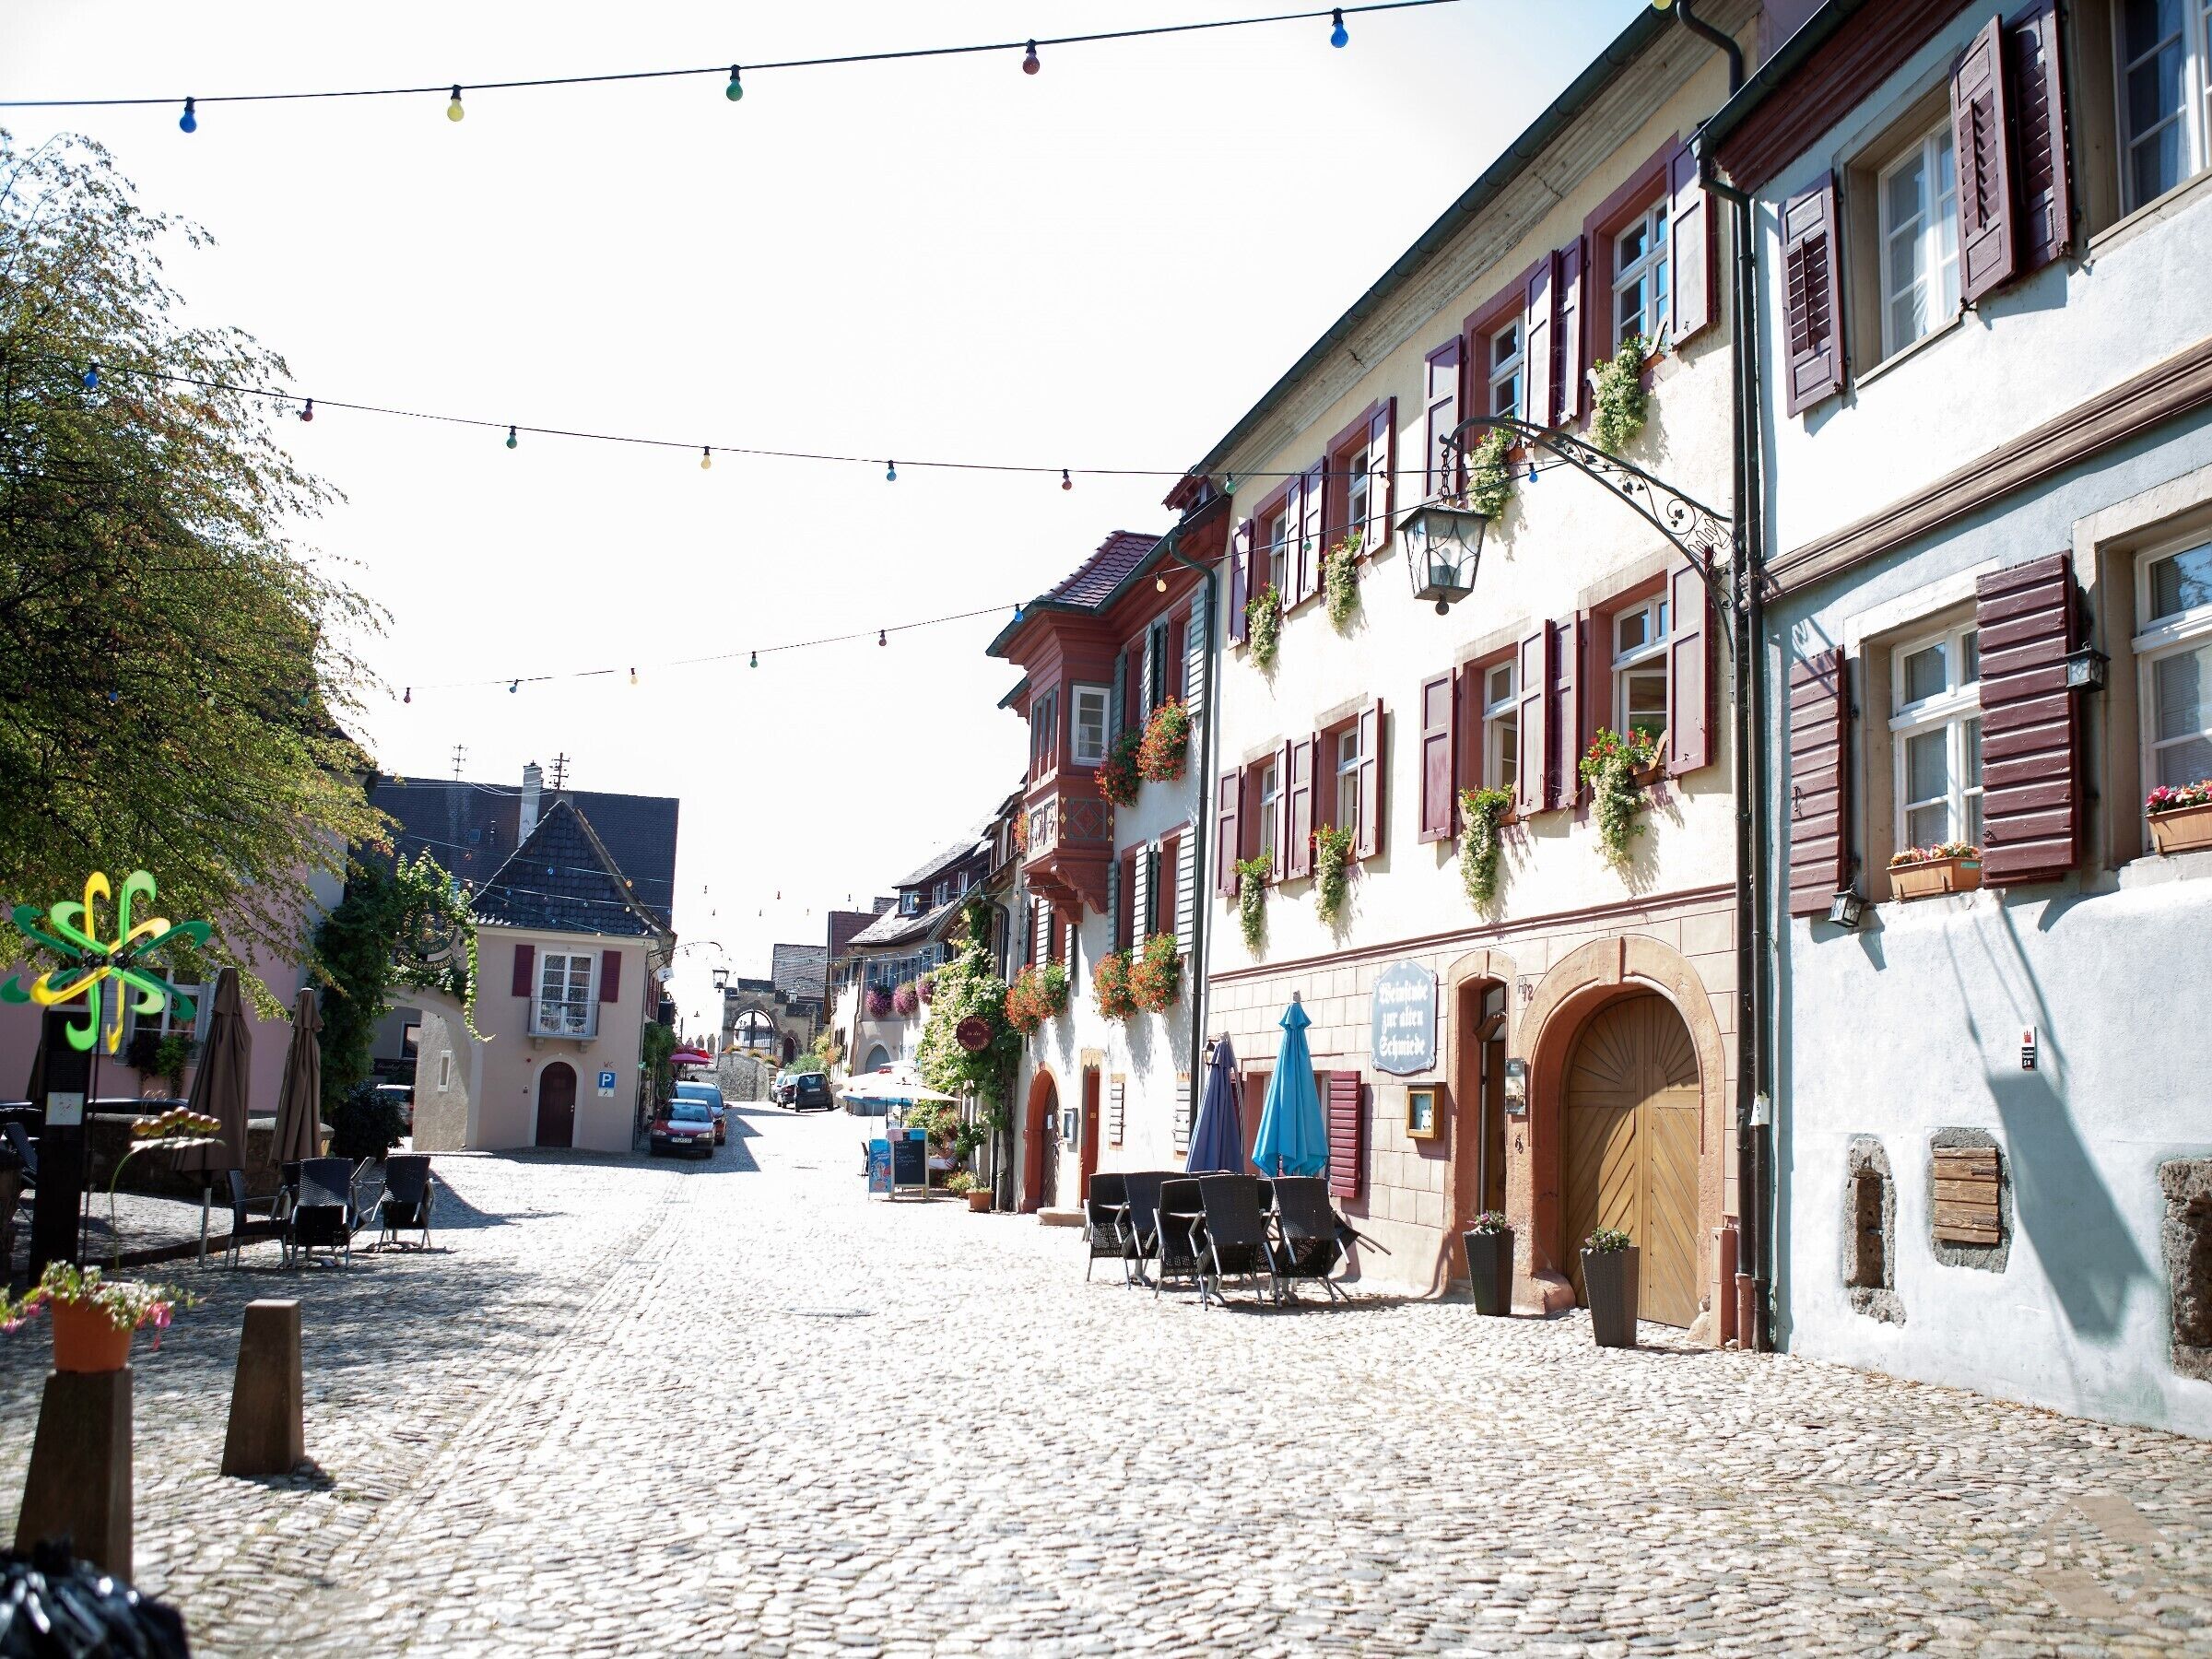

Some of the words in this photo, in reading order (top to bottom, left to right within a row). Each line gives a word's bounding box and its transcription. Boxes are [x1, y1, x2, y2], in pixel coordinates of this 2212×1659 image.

[397, 951, 453, 971] Weinverkauf
[1382, 1012, 1397, 1035] zur
[1399, 1005, 1424, 1027] alten
[1379, 1032, 1426, 1062] Schmiede
[602, 1073, 612, 1087] P
